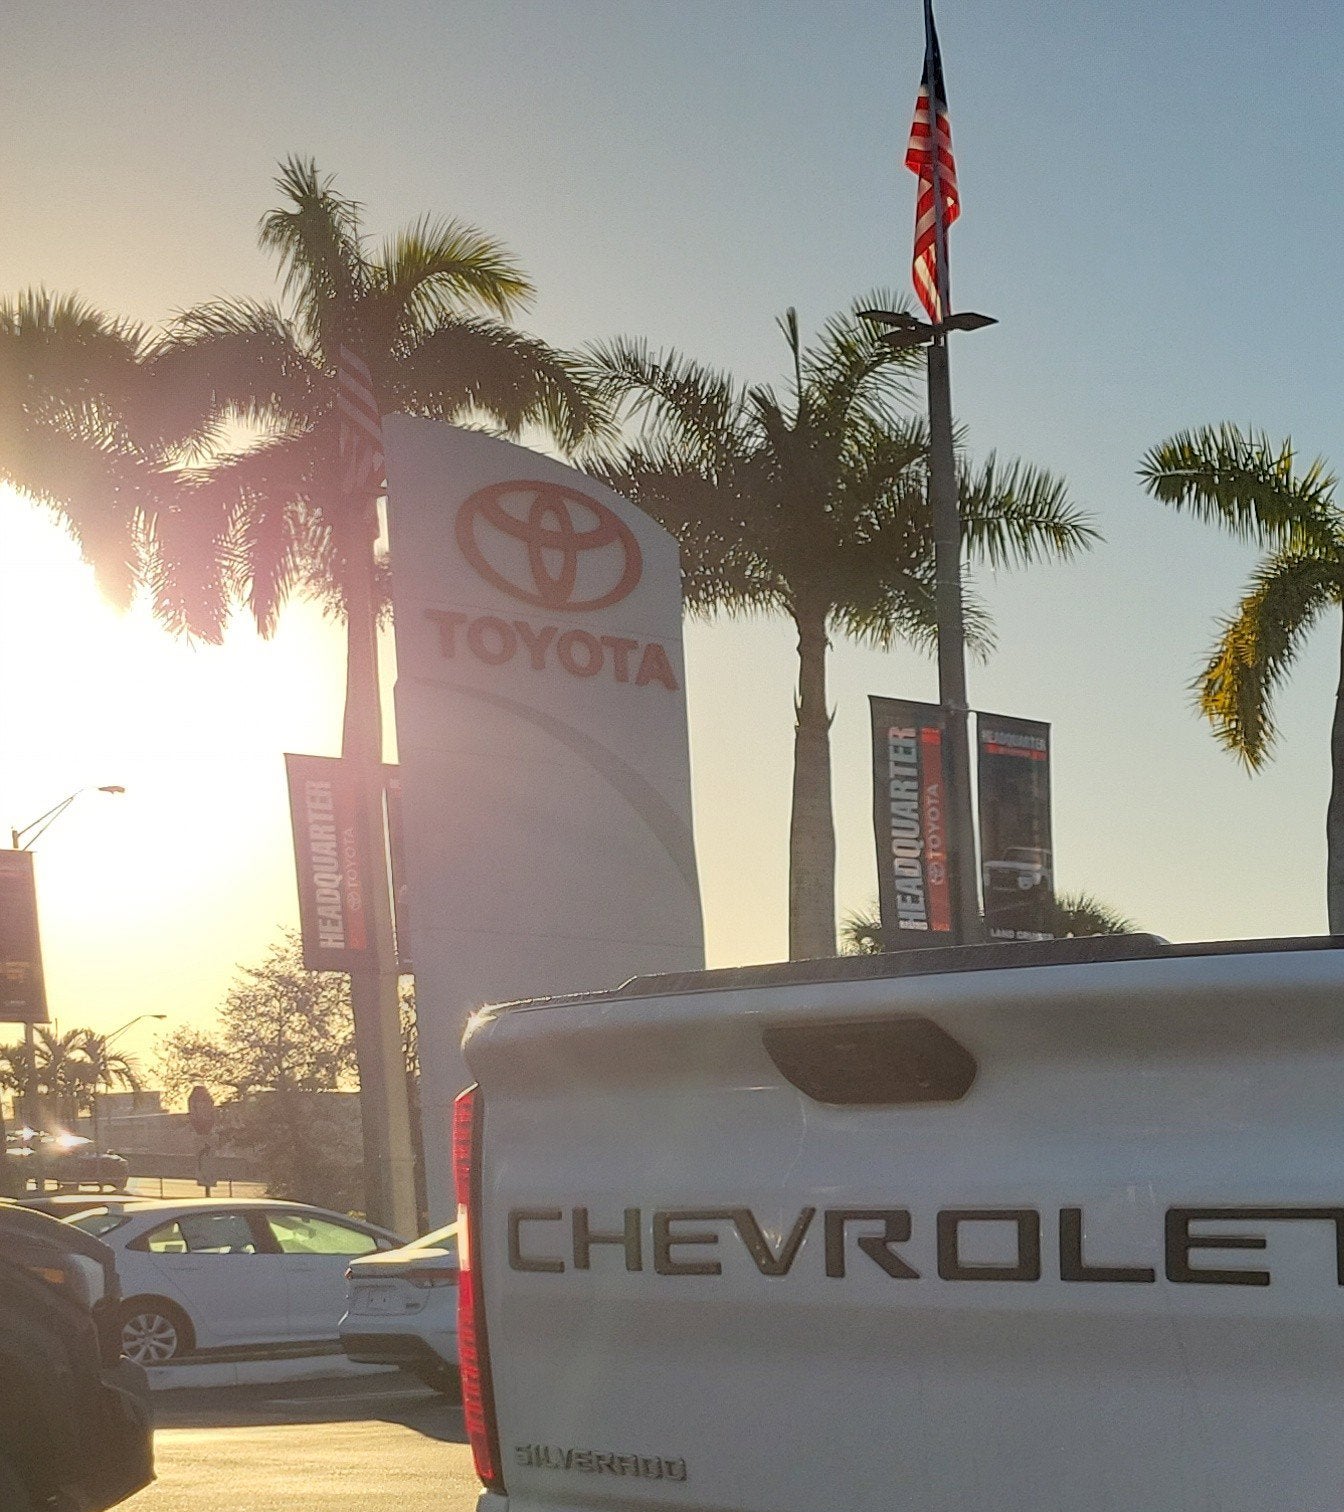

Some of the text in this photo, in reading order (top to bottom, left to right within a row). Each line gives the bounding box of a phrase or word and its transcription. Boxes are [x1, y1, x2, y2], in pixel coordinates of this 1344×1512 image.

[424, 609, 680, 692] TOYOTA
[888, 726, 929, 932] HEADQUARTER
[926, 783, 943, 860] TOYOTA
[305, 780, 346, 950] HEADQUARTER
[514, 1444, 688, 1482] SILVERADO
